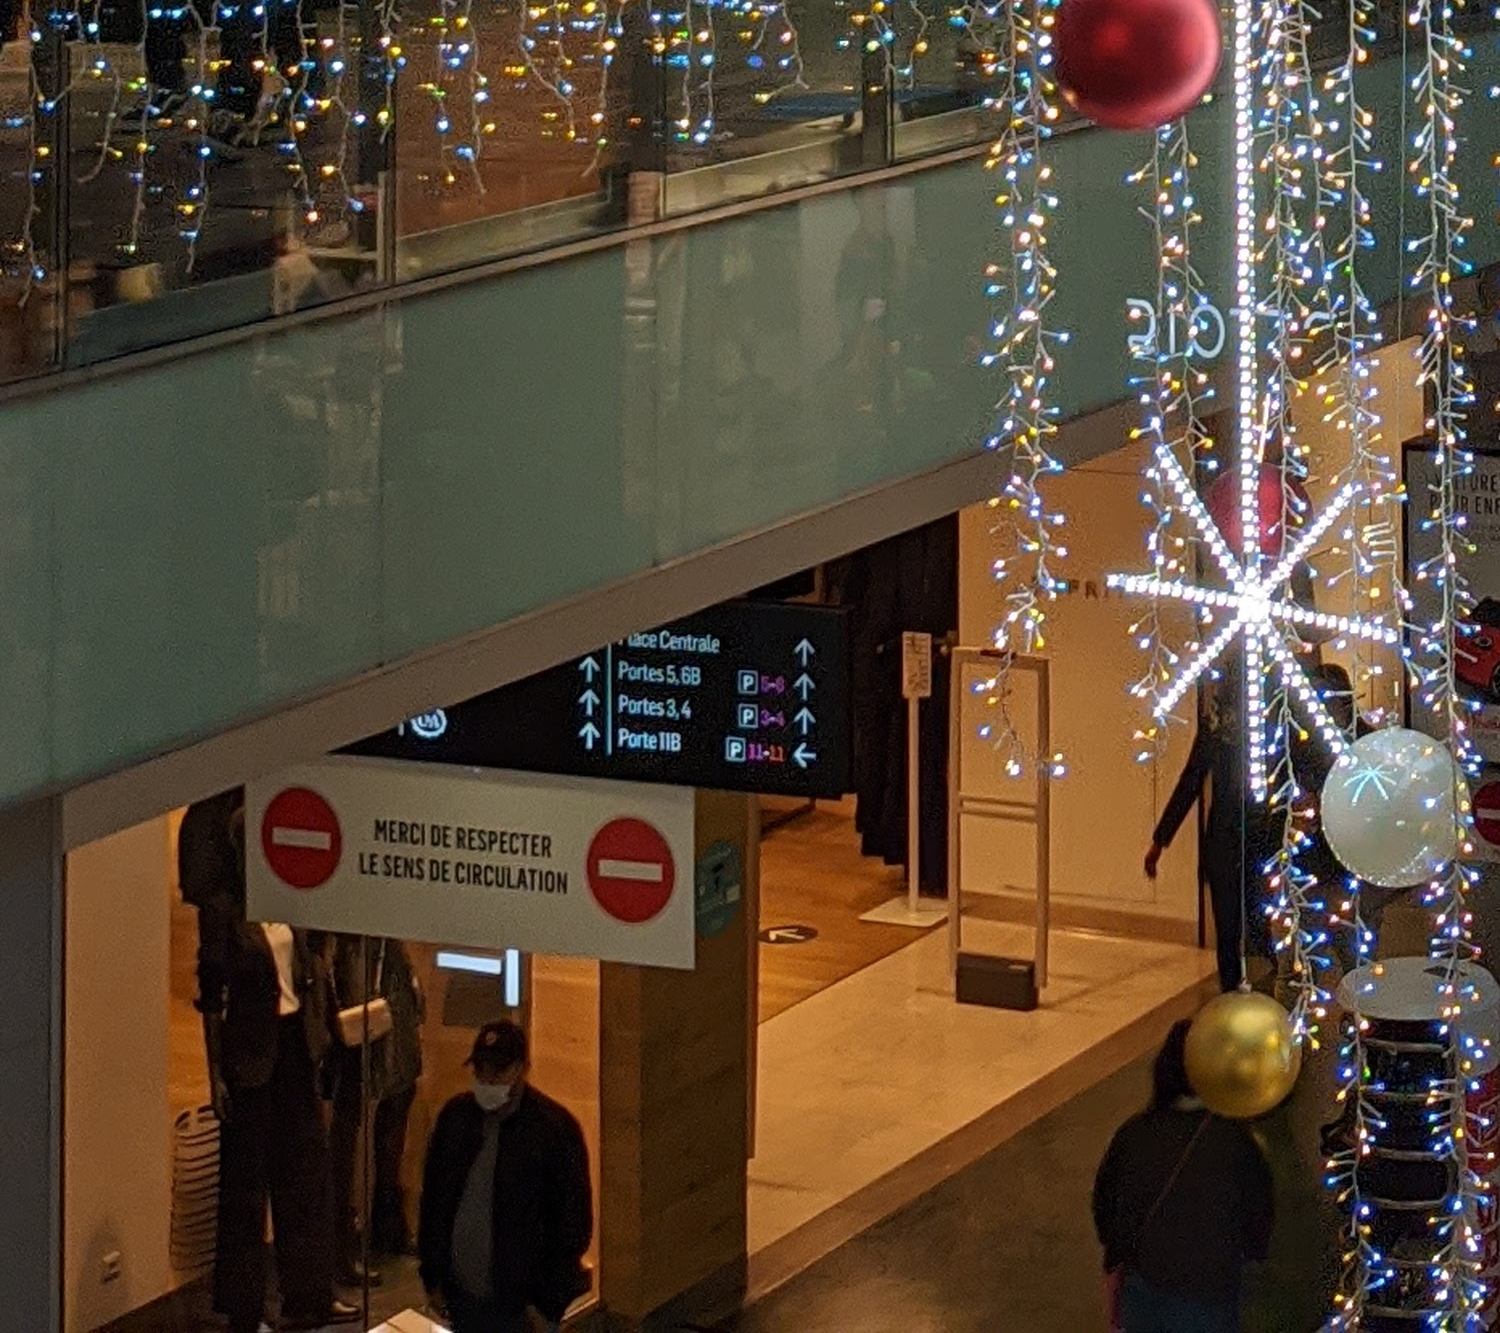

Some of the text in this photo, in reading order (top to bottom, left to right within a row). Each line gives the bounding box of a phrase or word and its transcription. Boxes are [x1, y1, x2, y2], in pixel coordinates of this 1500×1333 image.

[1430, 494, 1469, 514] PUR
[618, 630, 722, 655] lace Centrale
[617, 660, 665, 683] Portes
[617, 694, 665, 717] Portes
[617, 727, 657, 750] Porte
[374, 818, 552, 858] MERCI DE RESPECTER
[358, 852, 568, 894] LE SENS DE CIRCULATION
